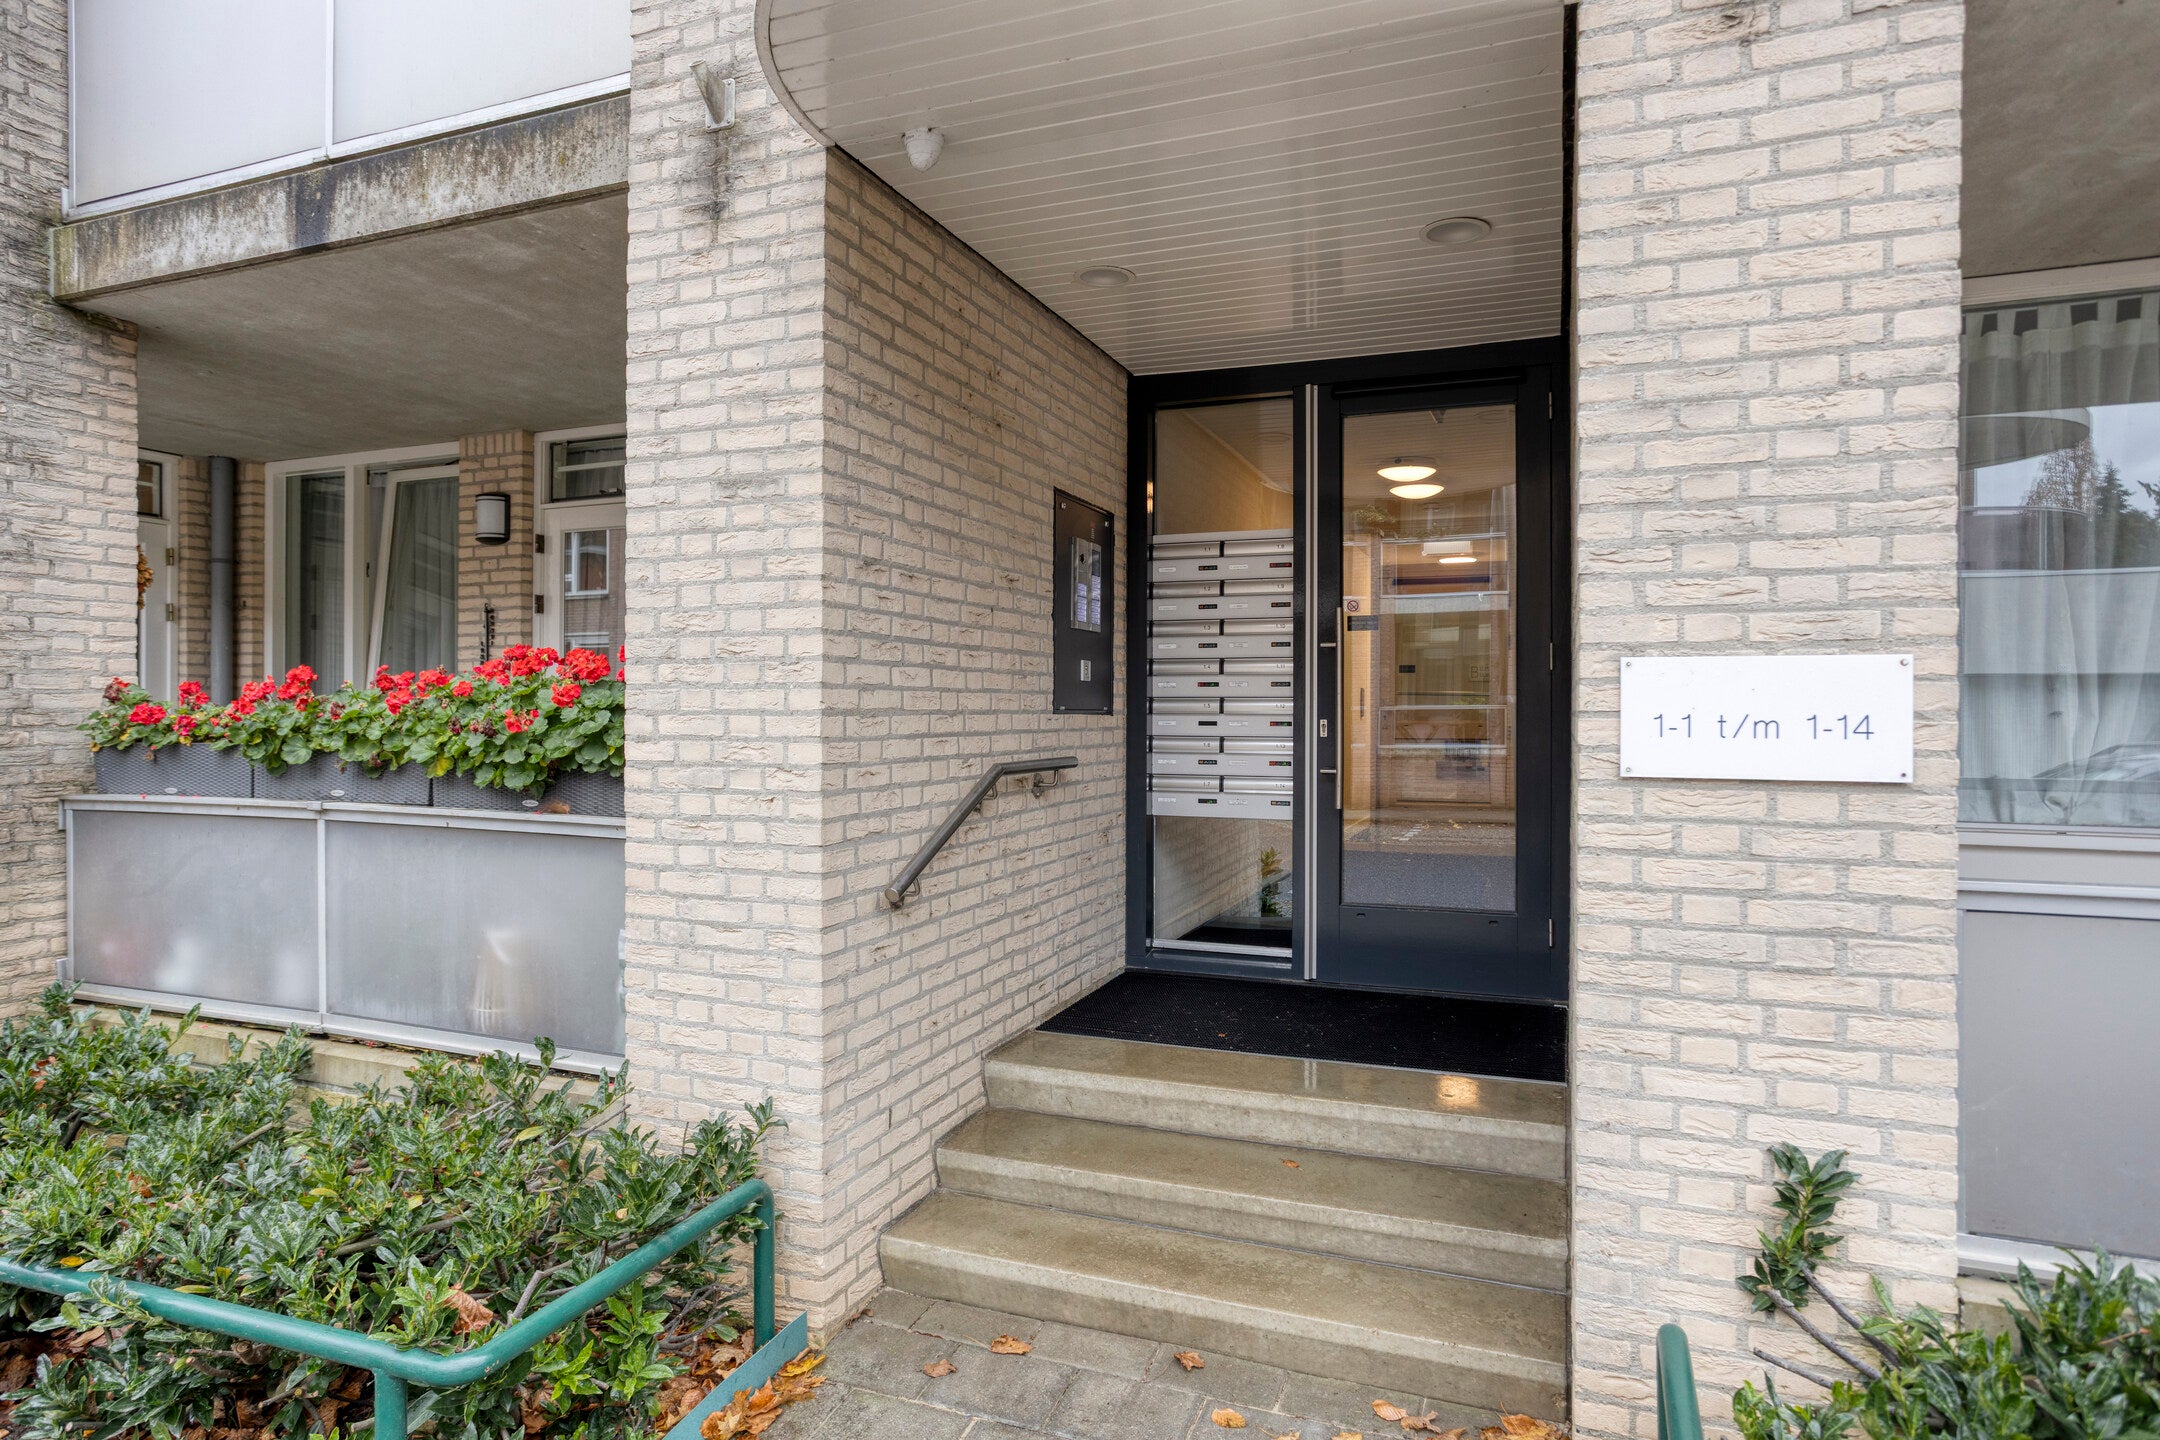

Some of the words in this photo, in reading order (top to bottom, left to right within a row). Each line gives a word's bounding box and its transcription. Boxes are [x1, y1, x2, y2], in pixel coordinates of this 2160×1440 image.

[1653, 713, 1692, 738] 1-1
[1717, 713, 1780, 739] t/m
[1805, 714, 1875, 741] 1-14
